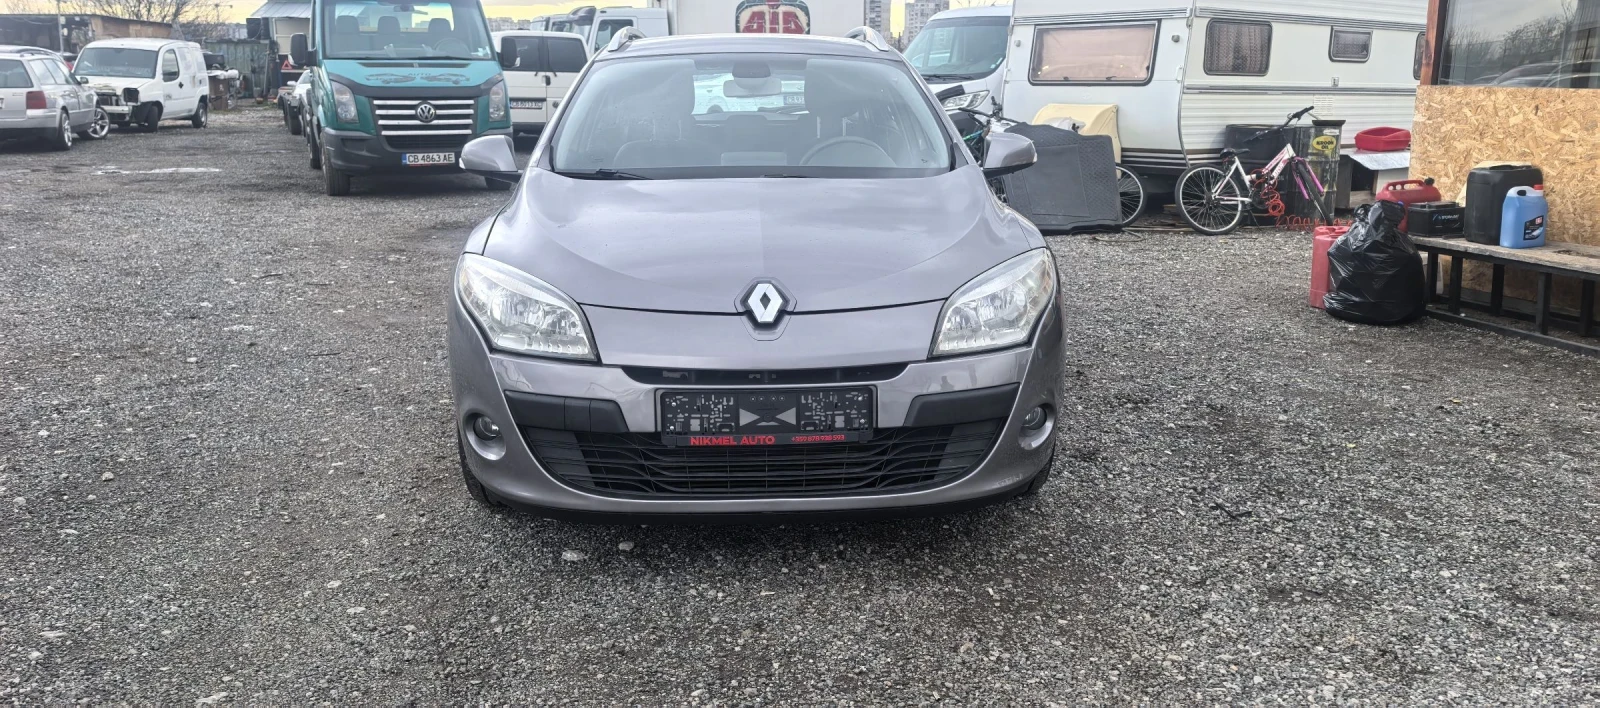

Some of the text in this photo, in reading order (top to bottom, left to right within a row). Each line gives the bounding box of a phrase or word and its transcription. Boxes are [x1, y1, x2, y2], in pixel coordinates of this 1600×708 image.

[407, 153, 453, 163] CB 4863 AE
[690, 435, 775, 446] NIKMEL AUTO
